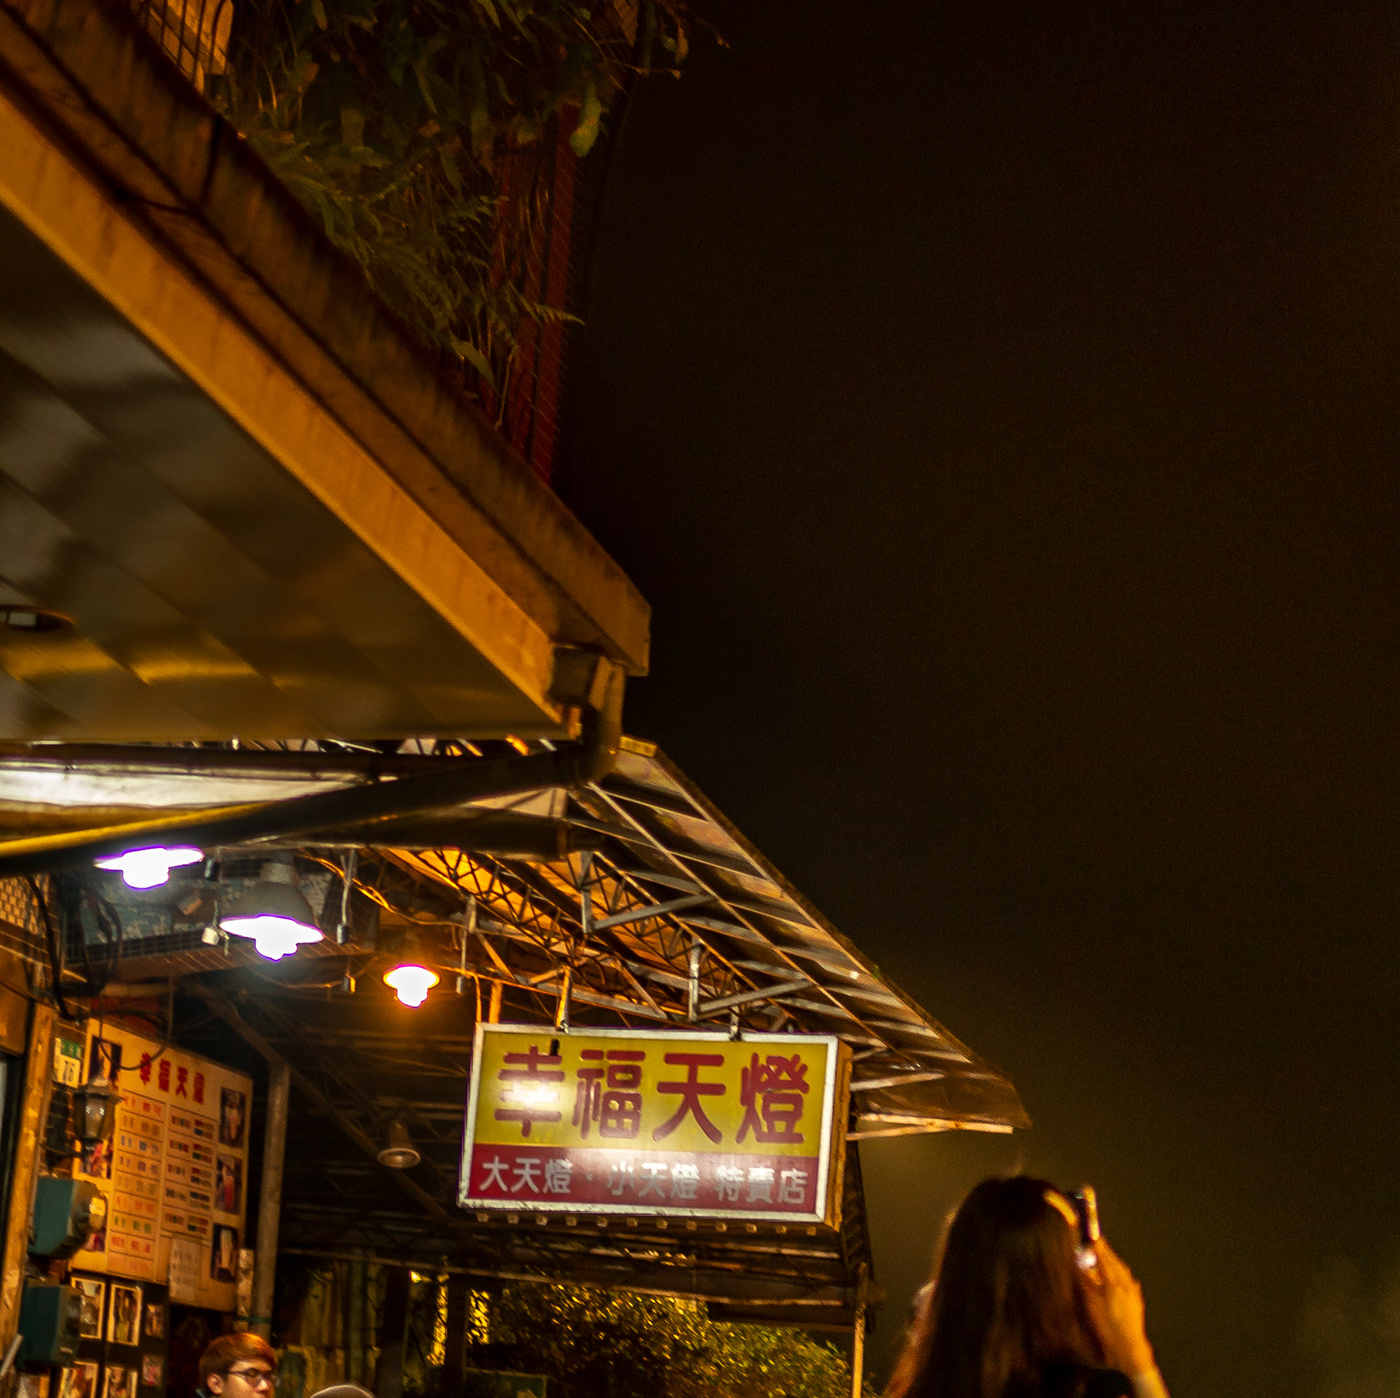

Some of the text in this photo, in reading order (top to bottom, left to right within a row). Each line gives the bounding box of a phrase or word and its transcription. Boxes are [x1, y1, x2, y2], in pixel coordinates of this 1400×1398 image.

[493, 1044, 810, 1145] 幸福天燈
[478, 1156, 809, 1205] 大天燈 小天燈 特賣店
